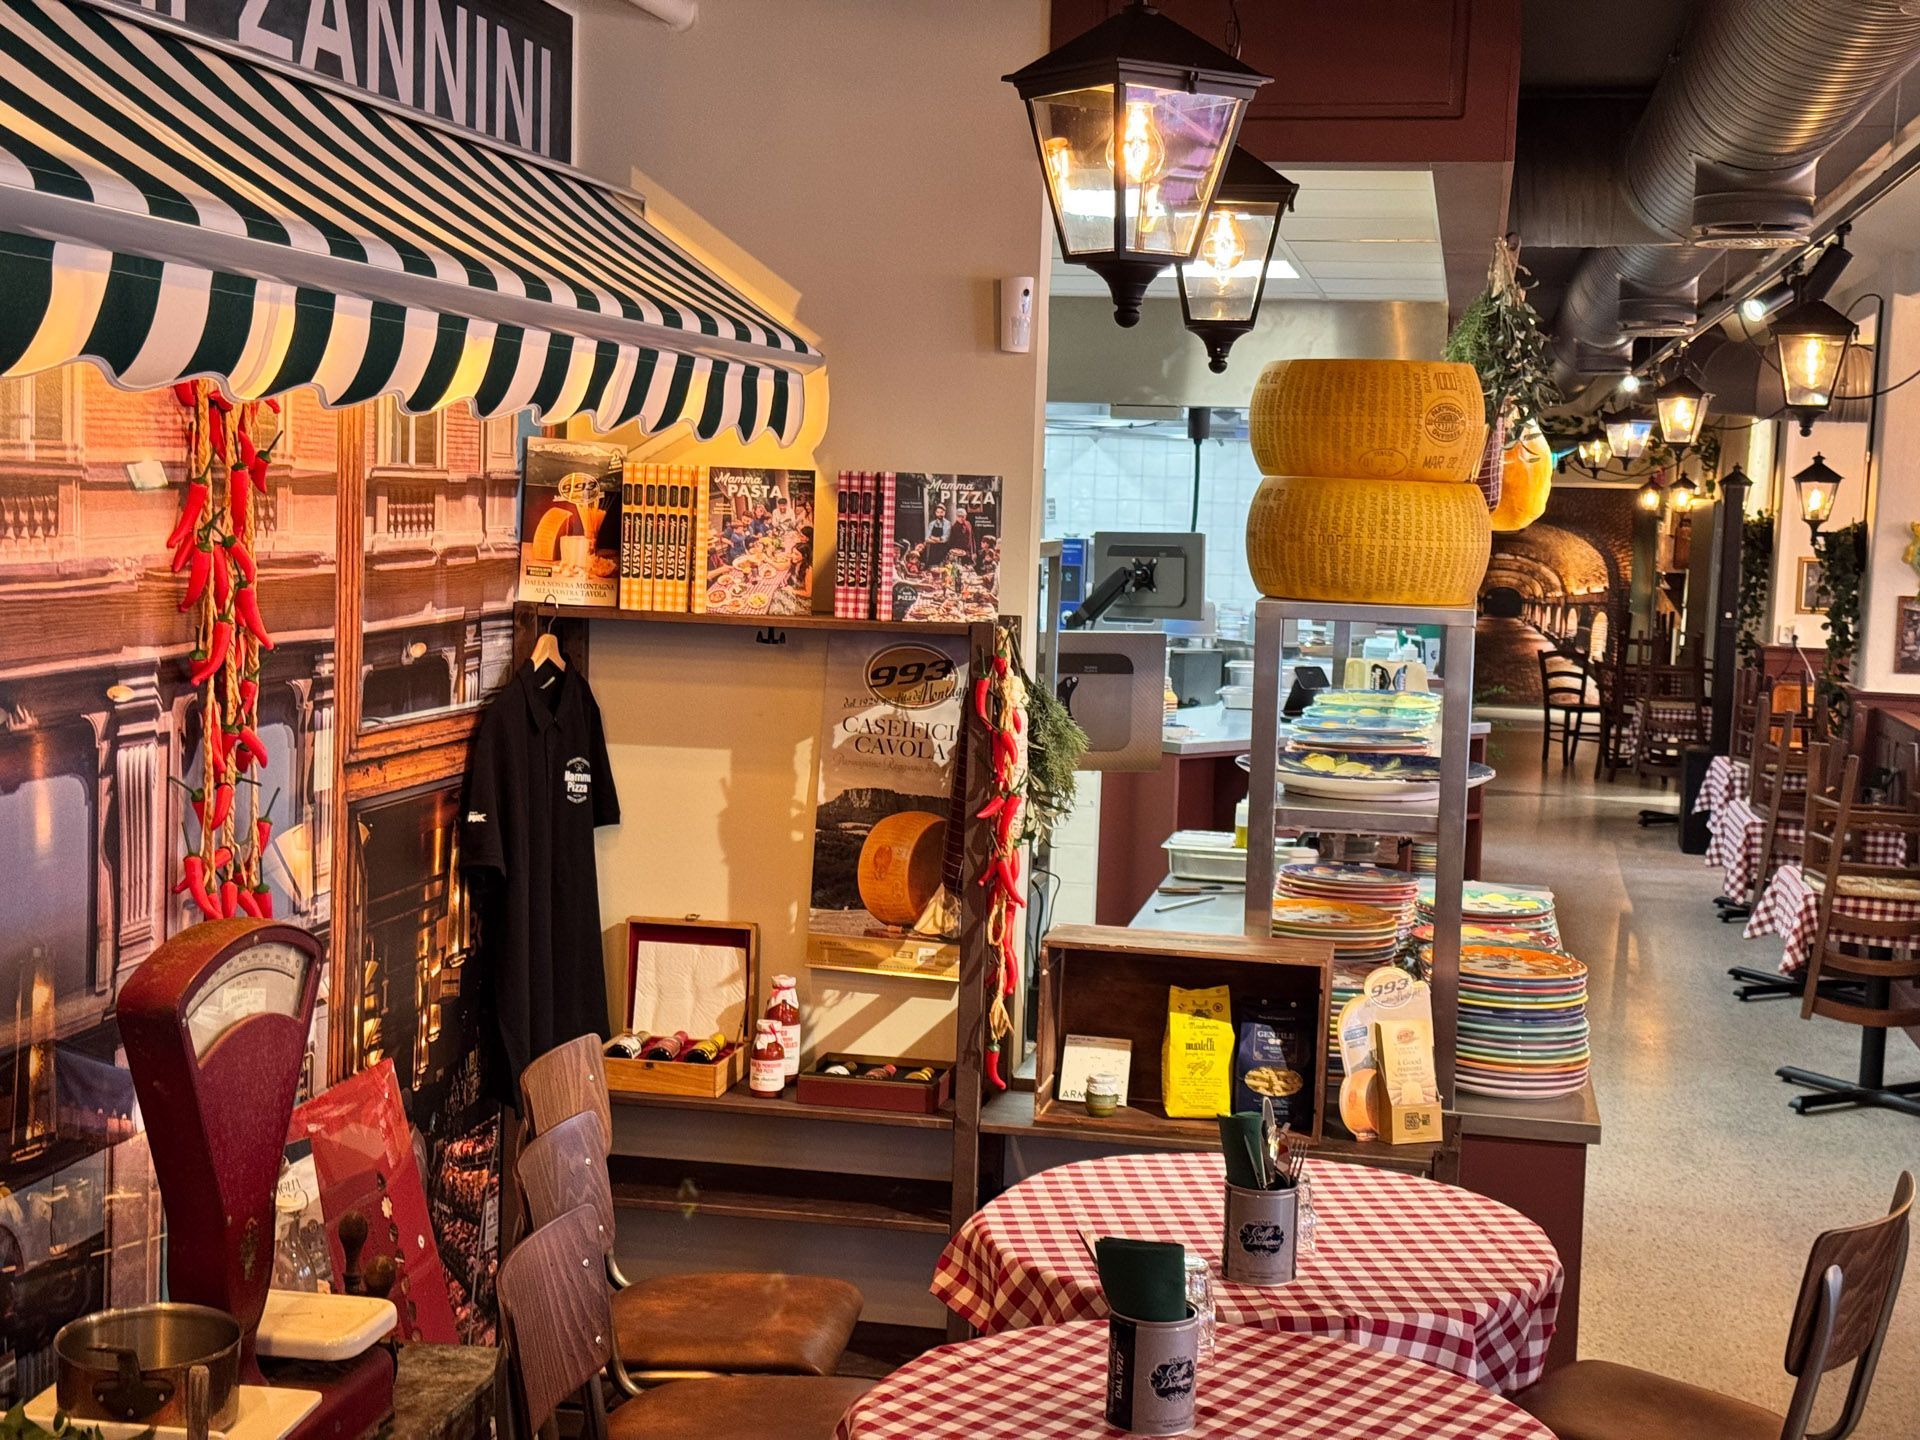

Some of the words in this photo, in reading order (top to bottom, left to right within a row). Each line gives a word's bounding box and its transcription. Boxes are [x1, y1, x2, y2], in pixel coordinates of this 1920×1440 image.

[1447, 457, 1458, 468] 22
[714, 471, 762, 487] Mamma
[727, 484, 782, 499] PASTA
[926, 479, 974, 492] Mamma
[941, 491, 995, 505] PIZZA
[622, 543, 630, 574] PASTA
[632, 543, 640, 575] PASTA
[644, 544, 652, 576] PASTA
[655, 544, 664, 576] PASTA
[667, 544, 675, 576] PASTA
[678, 546, 687, 577] PASTA
[837, 552, 845, 583] PIZZA
[848, 552, 856, 583] PIZZA
[860, 552, 868, 584] PIZZA
[576, 582, 614, 591] MONTAGNA
[581, 590, 607, 598] TAVOLA
[870, 659, 954, 689] 993
[842, 716, 960, 742] CASEIFICI
[854, 736, 946, 761] CAVOLA
[567, 781, 588, 793] Pizza
[1371, 978, 1409, 999] 993
[1257, 1030, 1295, 1040] GENTILE
[1116, 1351, 1125, 1376] 1927
[1115, 1378, 1123, 1399] DAL
